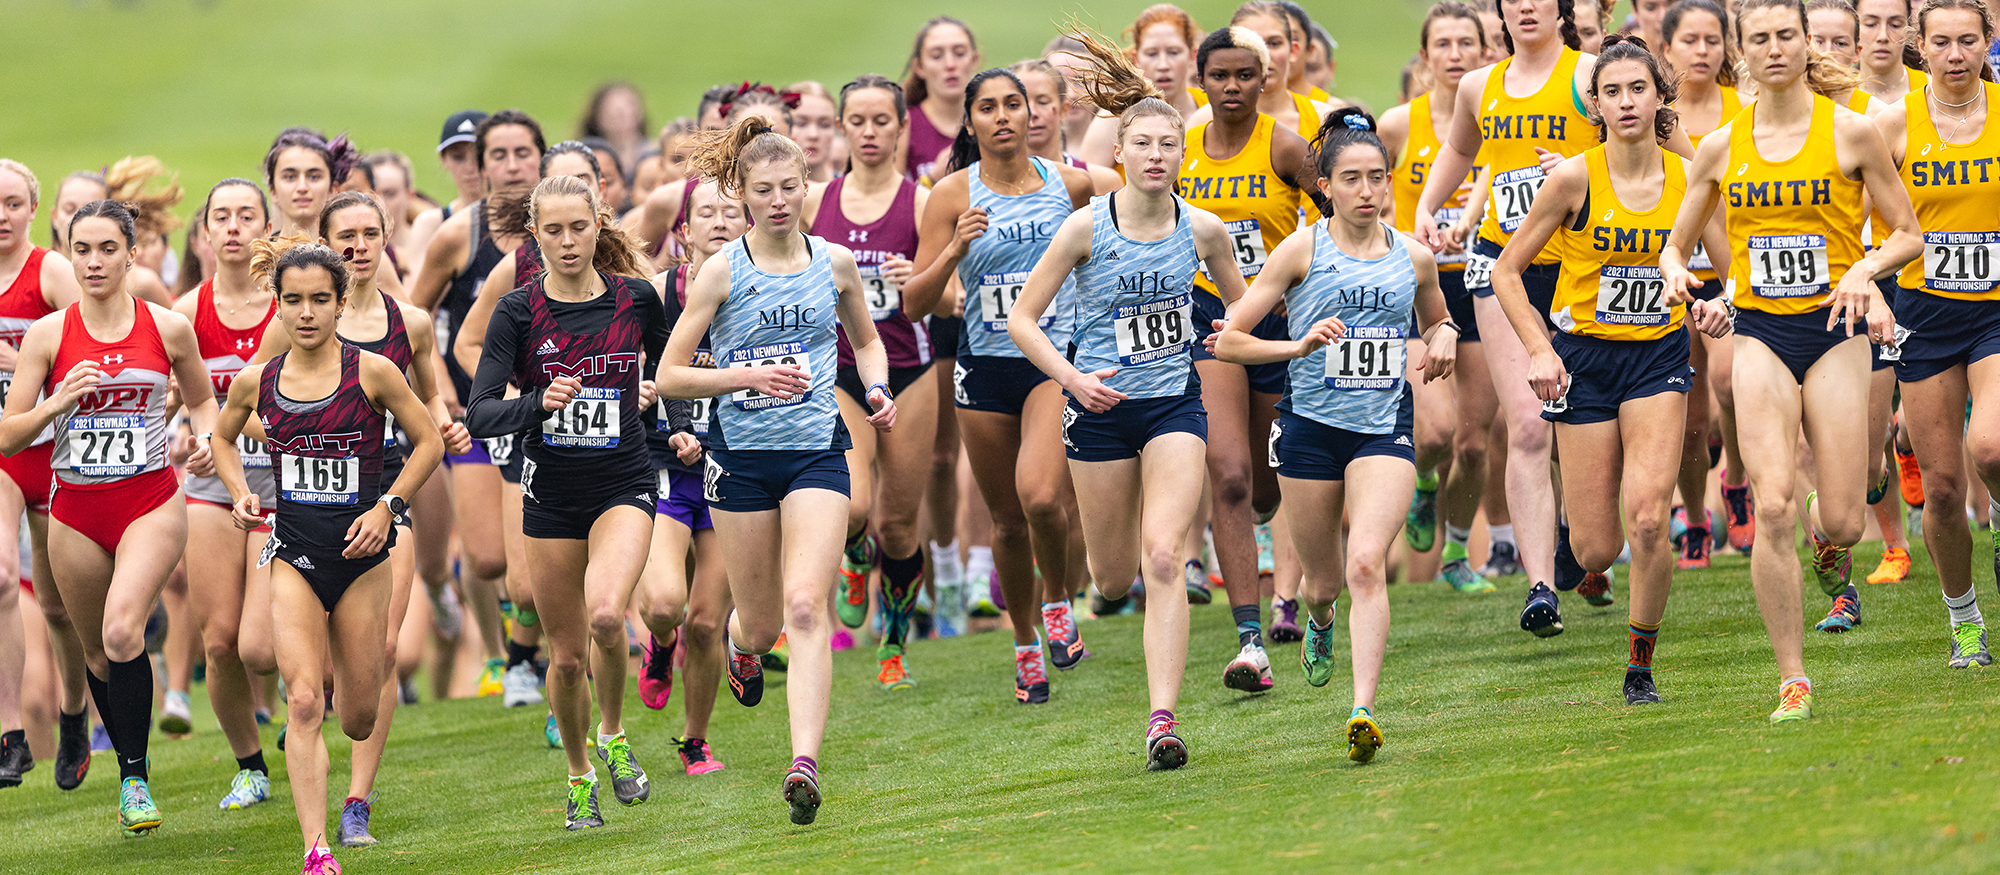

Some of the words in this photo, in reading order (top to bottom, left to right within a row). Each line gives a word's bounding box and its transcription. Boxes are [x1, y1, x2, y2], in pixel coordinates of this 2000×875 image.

[1482, 114, 1567, 141] SMITH
[1510, 165, 1543, 181] NEWMAC
[1912, 157, 2000, 187] SMIT
[1180, 174, 1267, 199] SMITH
[1728, 179, 1831, 207] SMITH
[997, 221, 1051, 245] MHC
[1243, 220, 1254, 230] XC
[1593, 225, 1672, 253] SMIT
[1751, 237, 1770, 248] 2021
[1771, 236, 1808, 248] NEWMAC
[1808, 236, 1820, 247] XC
[1928, 233, 1946, 243] 2021
[1948, 233, 1983, 244] NEWMAC
[1984, 232, 1996, 243] XC
[1606, 266, 1626, 277] 2021
[1627, 267, 1661, 278] NEWMAC
[1760, 249, 1816, 285] 199
[1934, 245, 1990, 280] 210
[983, 274, 1002, 285] 2021
[1117, 271, 1175, 297] MHC
[1933, 280, 1992, 291] CHAMPIONSHIP
[1337, 285, 1397, 313] MHC
[1608, 279, 1664, 313] 202
[1760, 285, 1820, 297] CHAMPIONSHIP
[1119, 306, 1138, 318] 2021
[1139, 300, 1175, 314] NEWMAC
[1175, 295, 1185, 307] XC
[758, 304, 817, 332] MHC
[1605, 313, 1662, 324] CHAMPIONSHIP
[1128, 311, 1182, 353] 189
[1354, 326, 1388, 338] NEWMAC
[1388, 327, 1399, 338] XC
[733, 348, 751, 361] 2021
[753, 344, 790, 359] NEWMAC
[790, 342, 802, 353] XC
[1129, 343, 1185, 365] CHAMPIONSHIP
[1338, 341, 1391, 377] 191
[543, 352, 637, 382] MIT
[604, 389, 615, 399] XC
[1334, 378, 1394, 389] CHAMPIONSHIP
[77, 387, 153, 411] WPI
[743, 394, 805, 411] CHAMPIONSHIP
[74, 418, 92, 429] 2021
[93, 417, 129, 429] NEWMAC
[129, 417, 140, 428] XC
[553, 400, 609, 435] 164
[80, 430, 135, 465] 273
[267, 431, 362, 453] MIT
[551, 435, 610, 447] CHAMPIONSHIP
[79, 466, 138, 477] CHAMPIONSHIP
[294, 457, 348, 492] 169
[290, 491, 350, 503] CHAMPIONSHIP
